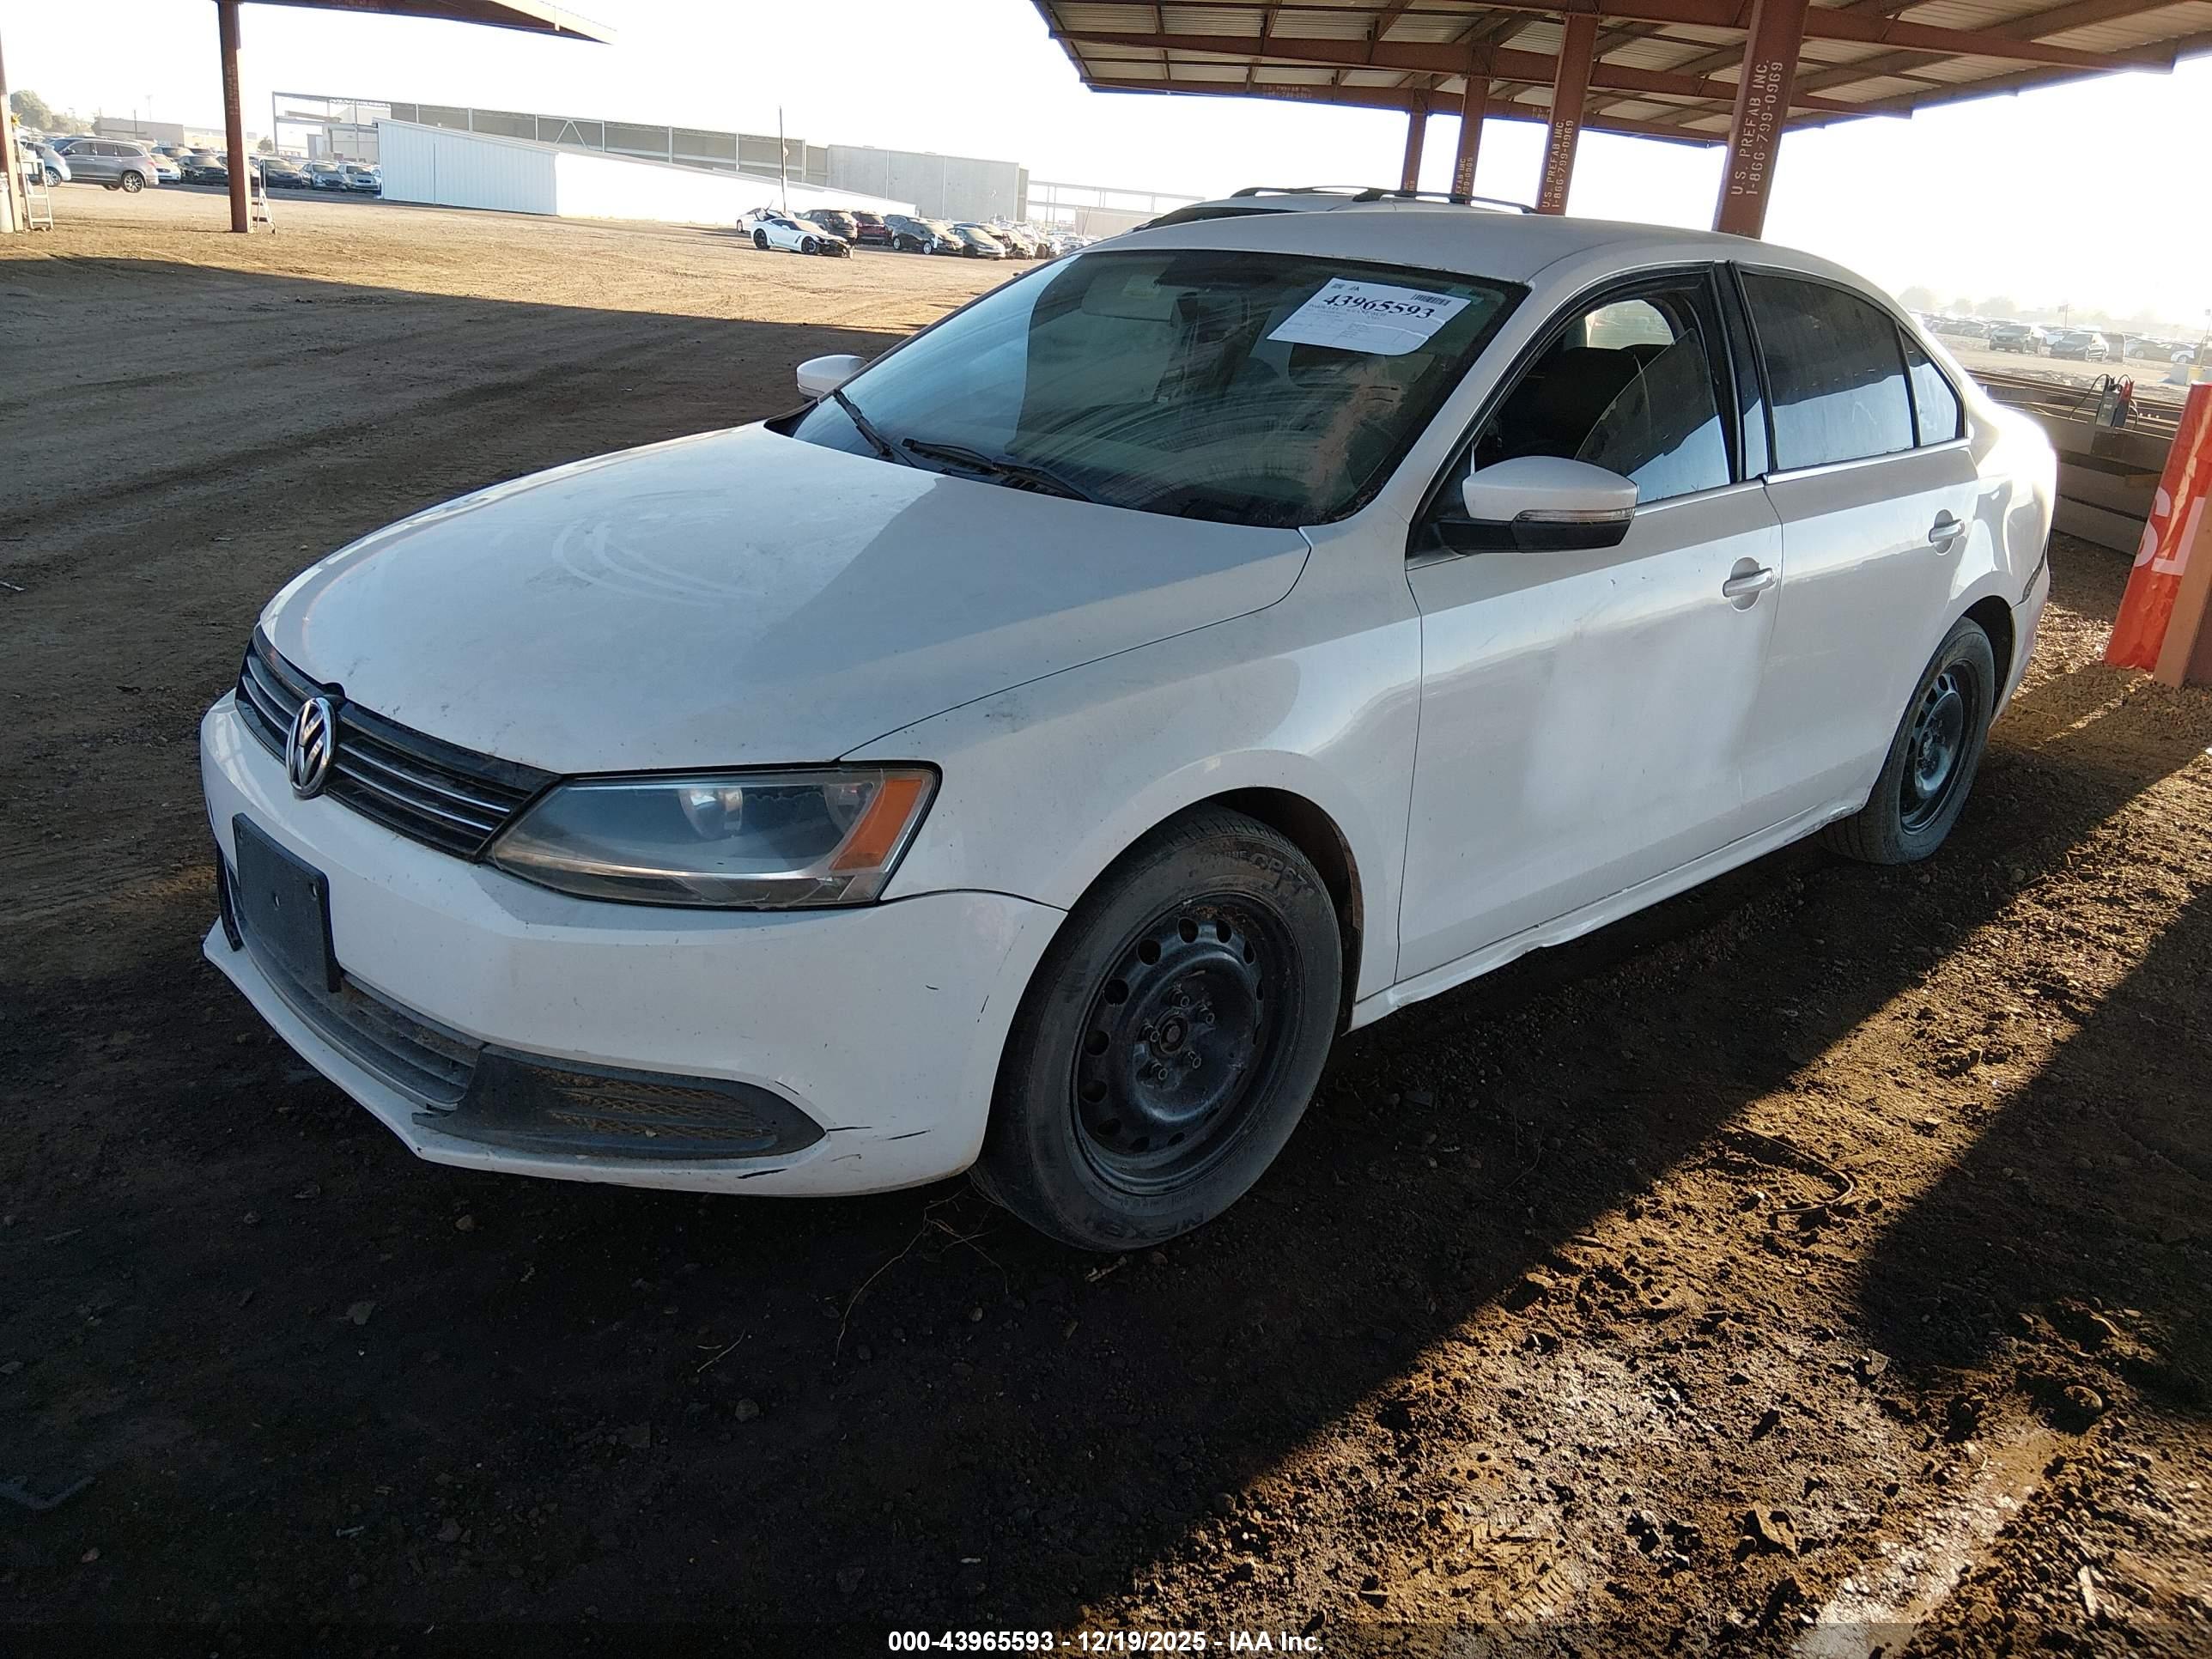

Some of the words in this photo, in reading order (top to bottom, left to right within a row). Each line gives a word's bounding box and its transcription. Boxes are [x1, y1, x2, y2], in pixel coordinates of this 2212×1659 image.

[1752, 59, 1770, 88] INC.
[1738, 97, 1761, 157] PREFAB
[1746, 62, 1784, 195] 1-866-799-0969
[1546, 143, 1560, 183] PREFAB
[1731, 167, 1749, 195] U.S.
[1323, 294, 1436, 319] 43965593
